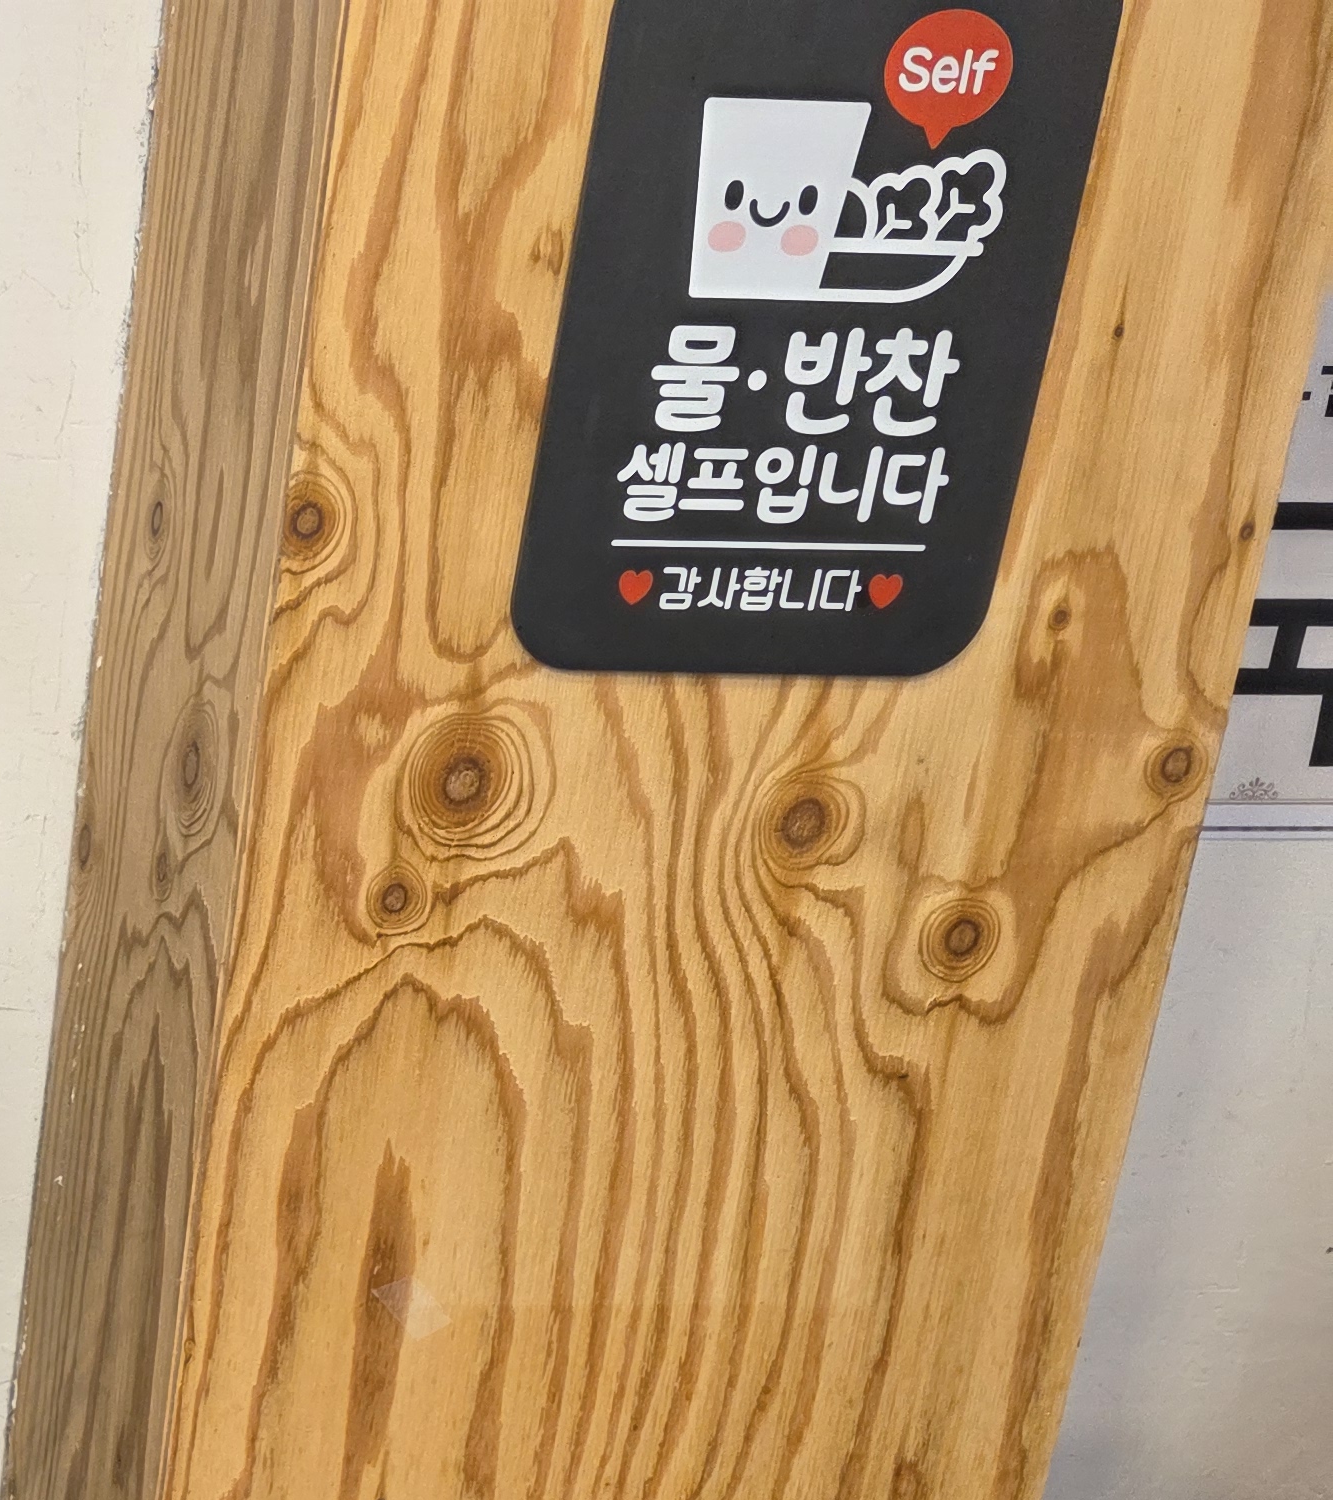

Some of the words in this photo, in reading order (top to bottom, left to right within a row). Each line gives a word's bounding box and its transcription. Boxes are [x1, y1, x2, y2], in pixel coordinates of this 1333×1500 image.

[898, 46, 1000, 95] Self
[616, 442, 950, 525] 셀프입니다
[658, 565, 863, 612] 감사합니다
